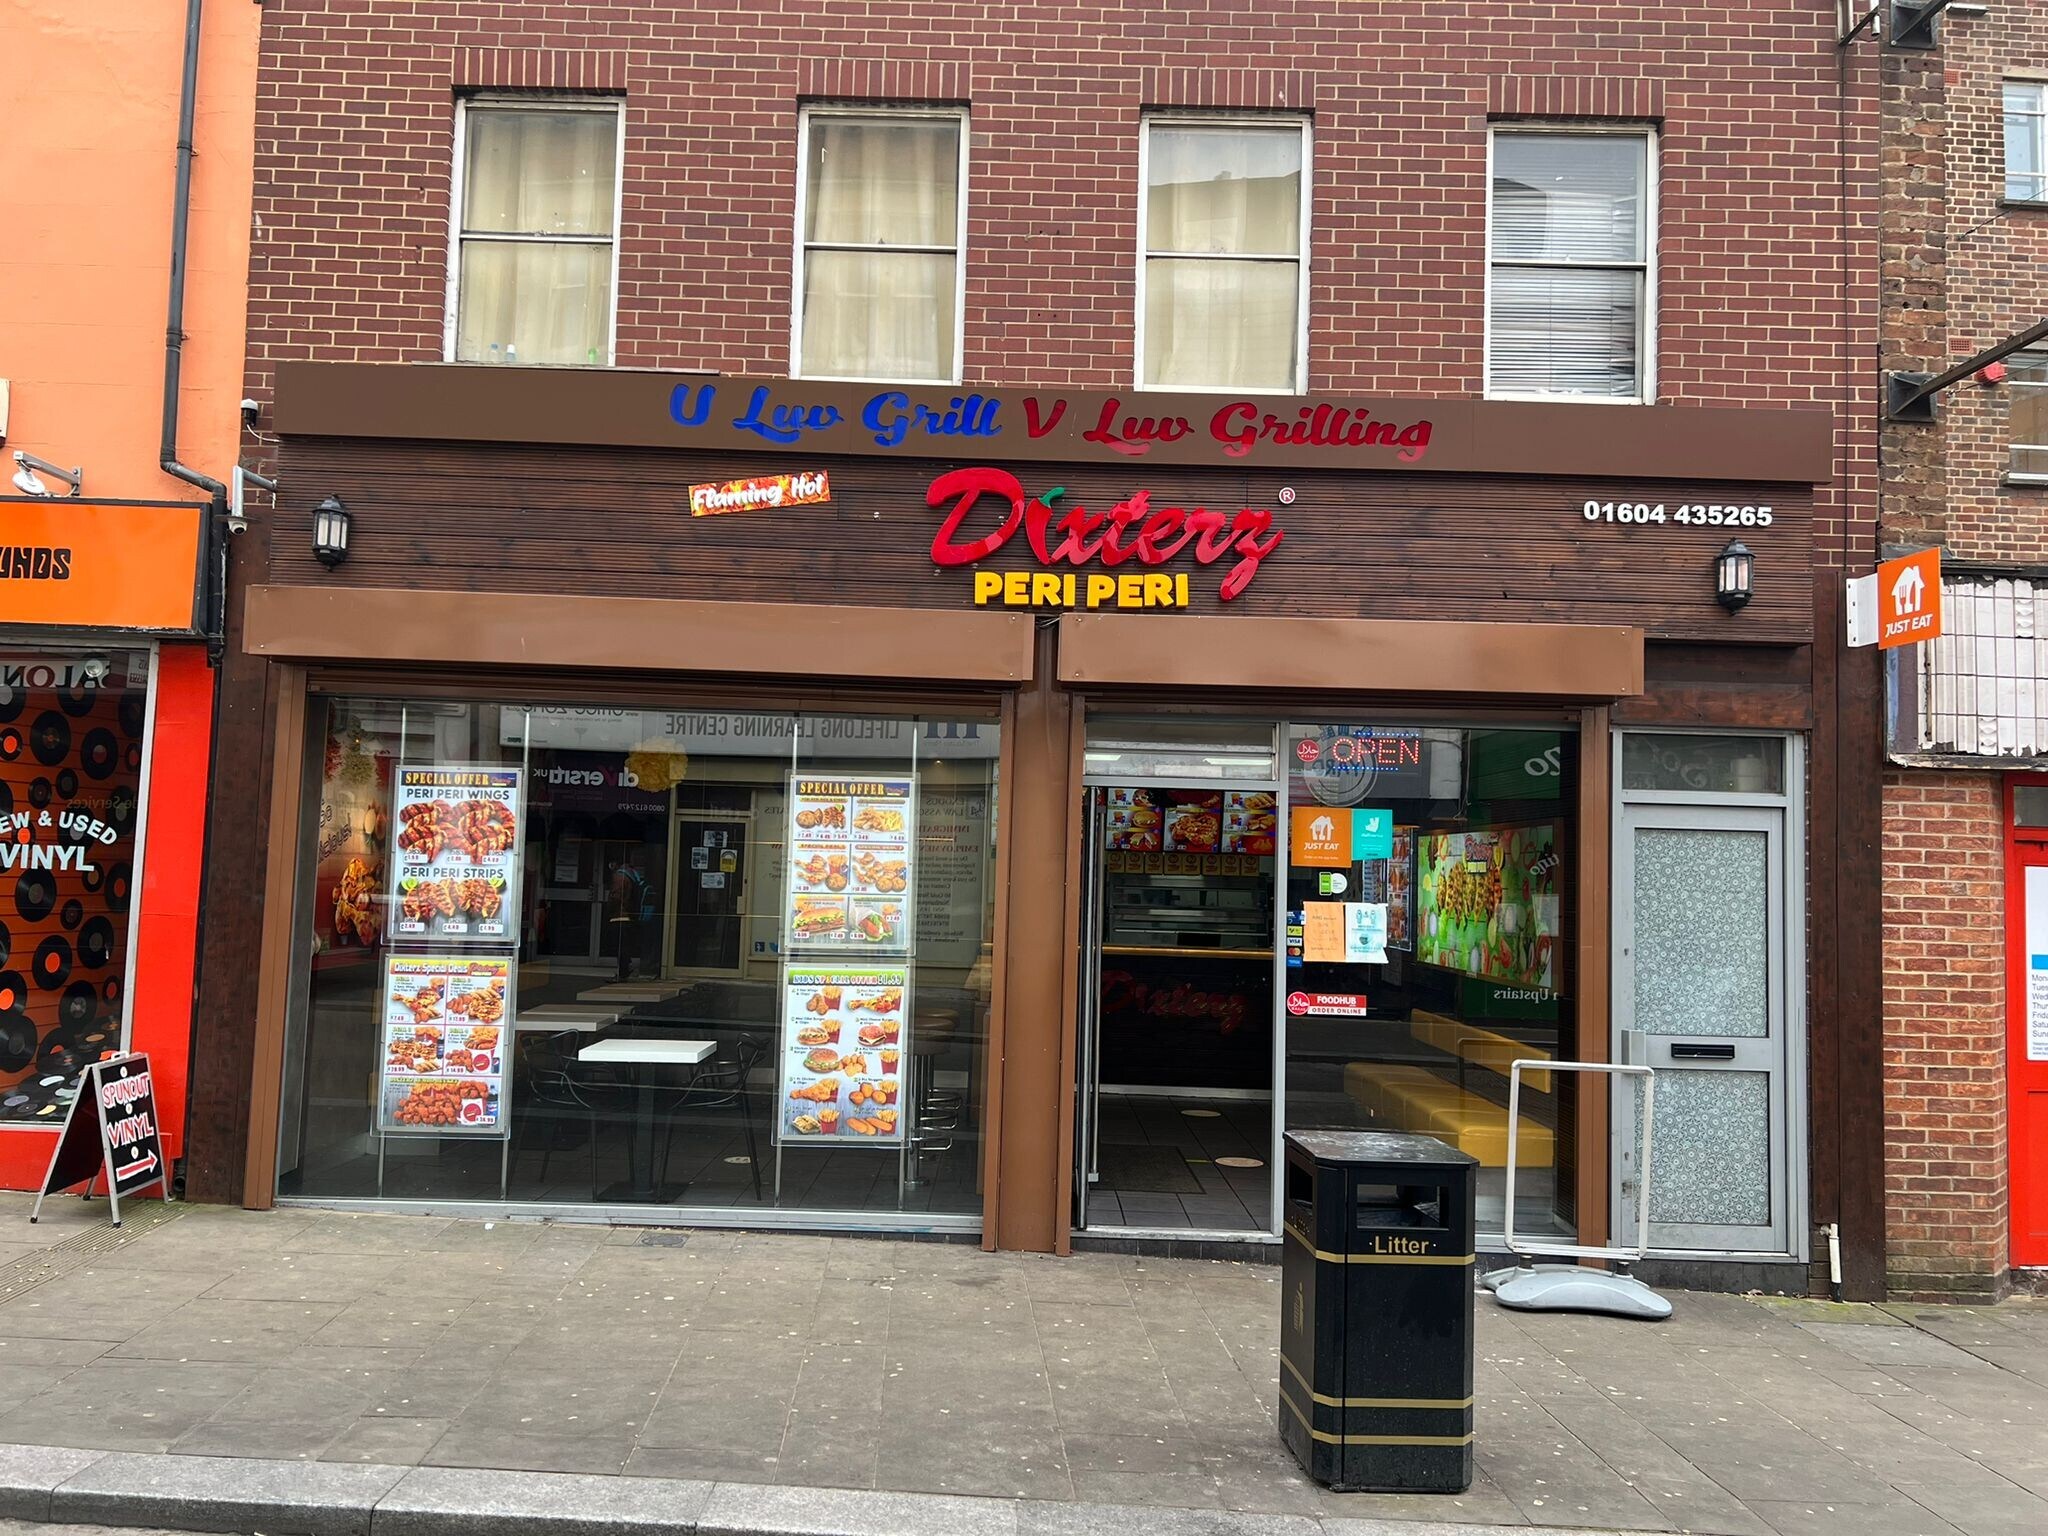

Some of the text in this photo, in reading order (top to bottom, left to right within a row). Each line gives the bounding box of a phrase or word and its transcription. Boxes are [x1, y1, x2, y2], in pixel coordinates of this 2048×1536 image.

[669, 383, 1432, 461] U Luv Grill V Luv Grilling
[693, 473, 825, 512] Flaming Hot
[1583, 500, 1774, 528] 01604 435265
[925, 467, 1285, 601] Dixterz
[974, 571, 1189, 609] PERI PERI
[1885, 613, 1934, 638] JUST EAT
[1333, 738, 1419, 764] OPEN
[405, 773, 489, 785] SPECIAL OFFER
[800, 782, 885, 795] SPECIAL OFFER
[406, 788, 510, 800] PERI PERI WINGS
[38, 810, 52, 827] &
[58, 811, 118, 845] USED
[0, 843, 95, 872] VINYL
[1303, 842, 1323, 850] JUST
[402, 867, 504, 879] PERI PERI STRIPS
[851, 975, 877, 984] OFFER
[1317, 996, 1357, 1005] FOODHUB
[102, 1072, 150, 1109] SPUNOUT
[106, 1112, 154, 1149] VINYL
[1375, 1236, 1429, 1254] Litter
